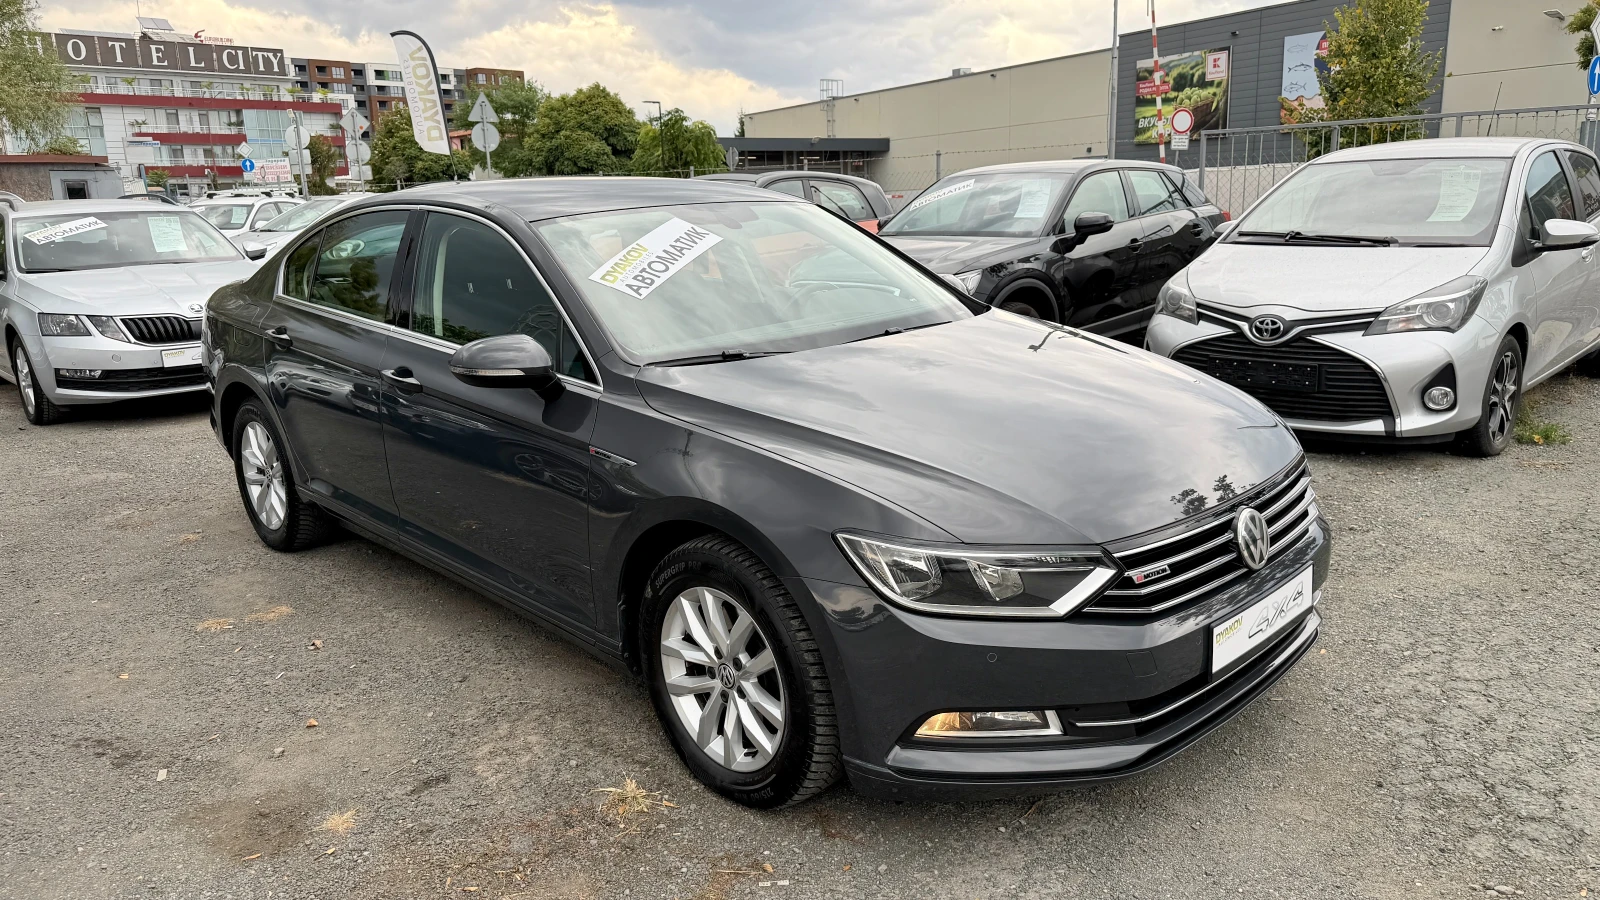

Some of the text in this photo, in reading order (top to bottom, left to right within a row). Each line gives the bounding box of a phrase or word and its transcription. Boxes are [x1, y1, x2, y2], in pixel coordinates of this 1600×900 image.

[222, 49, 282, 72] CITY
[36, 220, 103, 244] АВТОМАТИК
[600, 243, 649, 284] DYAKOV
[620, 251, 654, 283] AUTOMOBILES
[625, 226, 710, 296] АВТОМАТИК
[655, 562, 686, 589] SUPERGRIP
[1136, 566, 1168, 583] MOTION
[1215, 615, 1243, 645] DYAKOV
